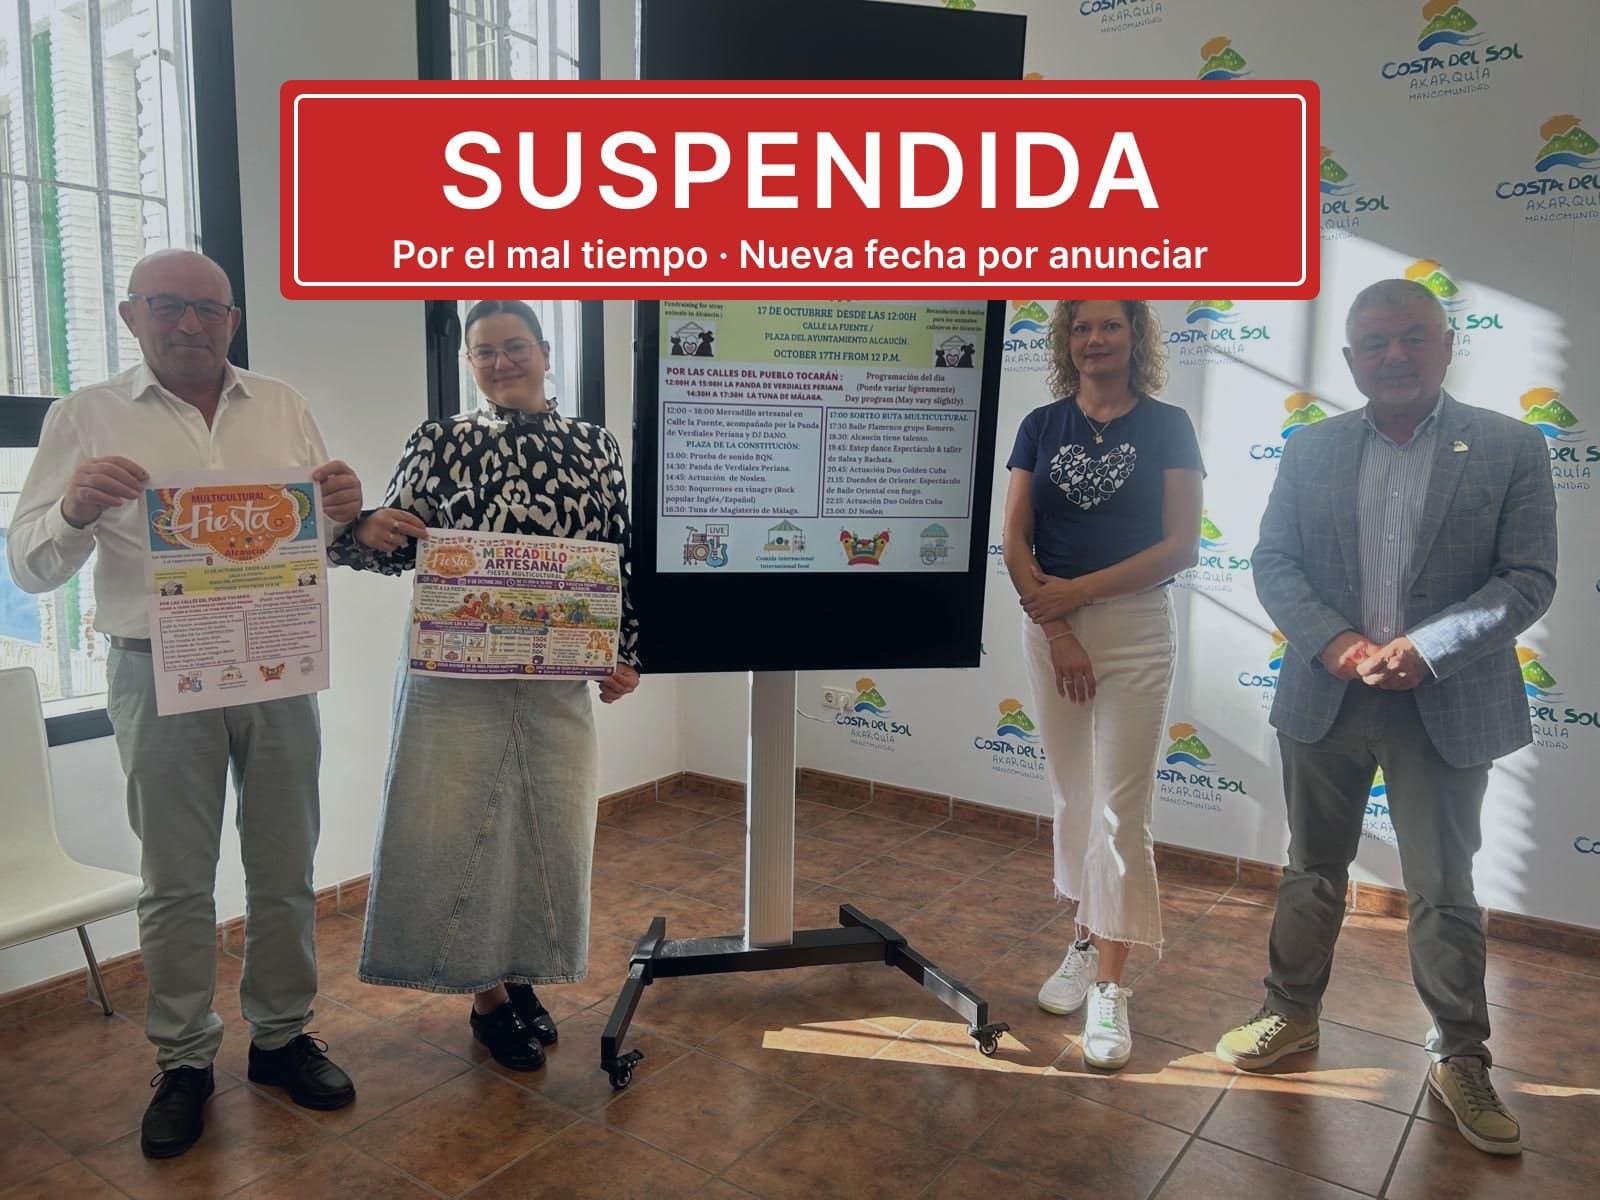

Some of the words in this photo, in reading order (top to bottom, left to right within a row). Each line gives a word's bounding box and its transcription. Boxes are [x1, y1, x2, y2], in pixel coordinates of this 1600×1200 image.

[1382, 57, 1444, 79] COSTA
[1485, 43, 1524, 63] SOL
[1496, 179, 1564, 199] COSTA
[758, 306, 768, 314] 17
[769, 307, 782, 315] DE
[837, 310, 868, 320] DESDE
[868, 310, 886, 320] LAS
[803, 322, 827, 331] CALLE
[839, 324, 869, 332] FUENTE
[792, 334, 807, 342] DEL
[808, 334, 868, 344] AYUNTAMIENTO
[774, 350, 817, 360] OCTOBER
[820, 350, 841, 360] 17TH
[843, 352, 869, 361] FROM
[871, 353, 880, 361] 12
[666, 368, 686, 376] POR
[688, 368, 704, 376] LAS
[706, 369, 738, 377] CALLES
[741, 370, 757, 378] DEL
[760, 370, 794, 380] PUEBLO
[921, 373, 932, 381] del
[845, 395, 859, 404] Day
[186, 499, 282, 540] Fiesta
[431, 552, 471, 569] Fiesta
[483, 547, 567, 563] MERCADILLO
[485, 559, 565, 574] ARTESANAL
[835, 713, 870, 728] COSTA
[974, 736, 1015, 754] COSTA
